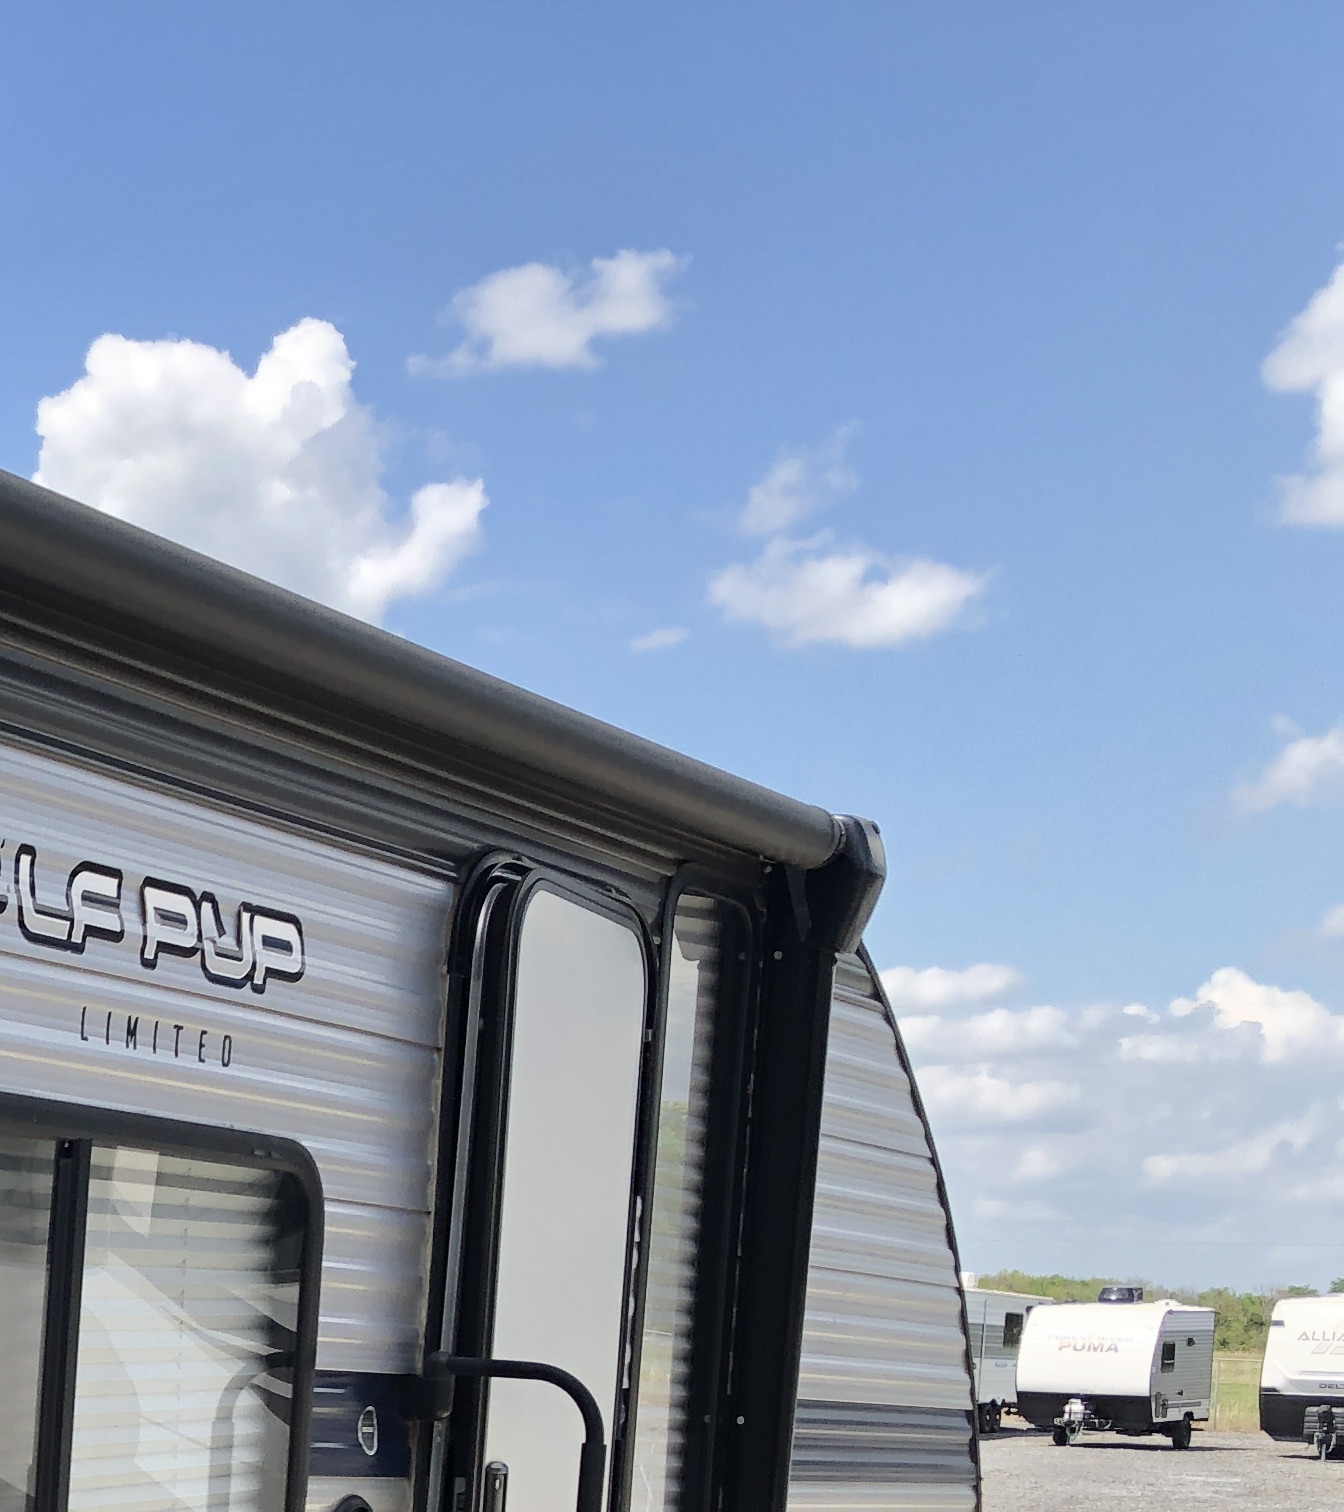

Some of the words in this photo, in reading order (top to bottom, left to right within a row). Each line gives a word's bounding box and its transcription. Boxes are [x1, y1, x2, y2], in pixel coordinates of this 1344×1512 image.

[140, 876, 306, 994] PUP
[79, 1005, 232, 1067] LIMITED
[1058, 1341, 1119, 1353] PUMA
